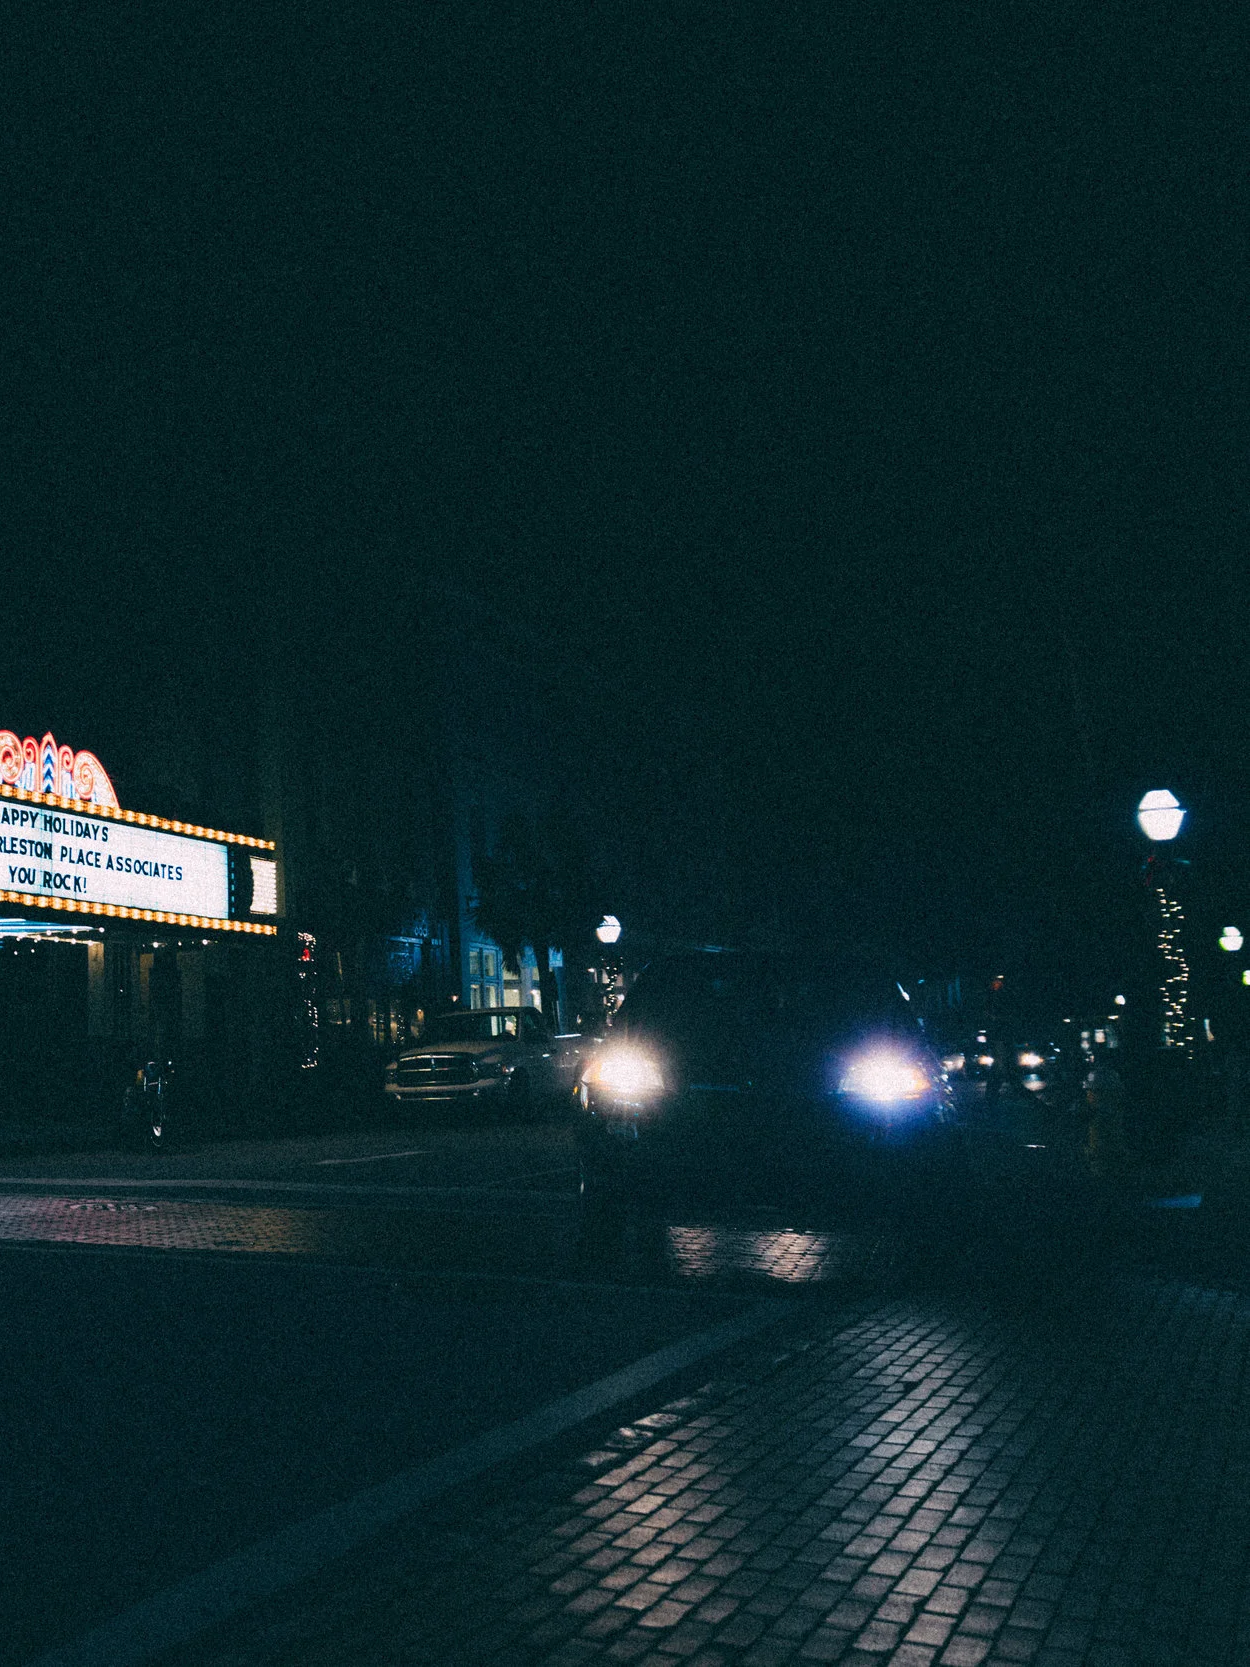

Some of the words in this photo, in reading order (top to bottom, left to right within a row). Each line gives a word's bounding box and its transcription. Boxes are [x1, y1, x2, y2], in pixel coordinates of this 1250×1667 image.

[43, 815, 109, 842] HOLIDAYS
[60, 845, 101, 868] PLACE
[106, 854, 183, 881] ASSOCIATES
[8, 865, 36, 885] YOU
[43, 870, 87, 894] ROCK!
